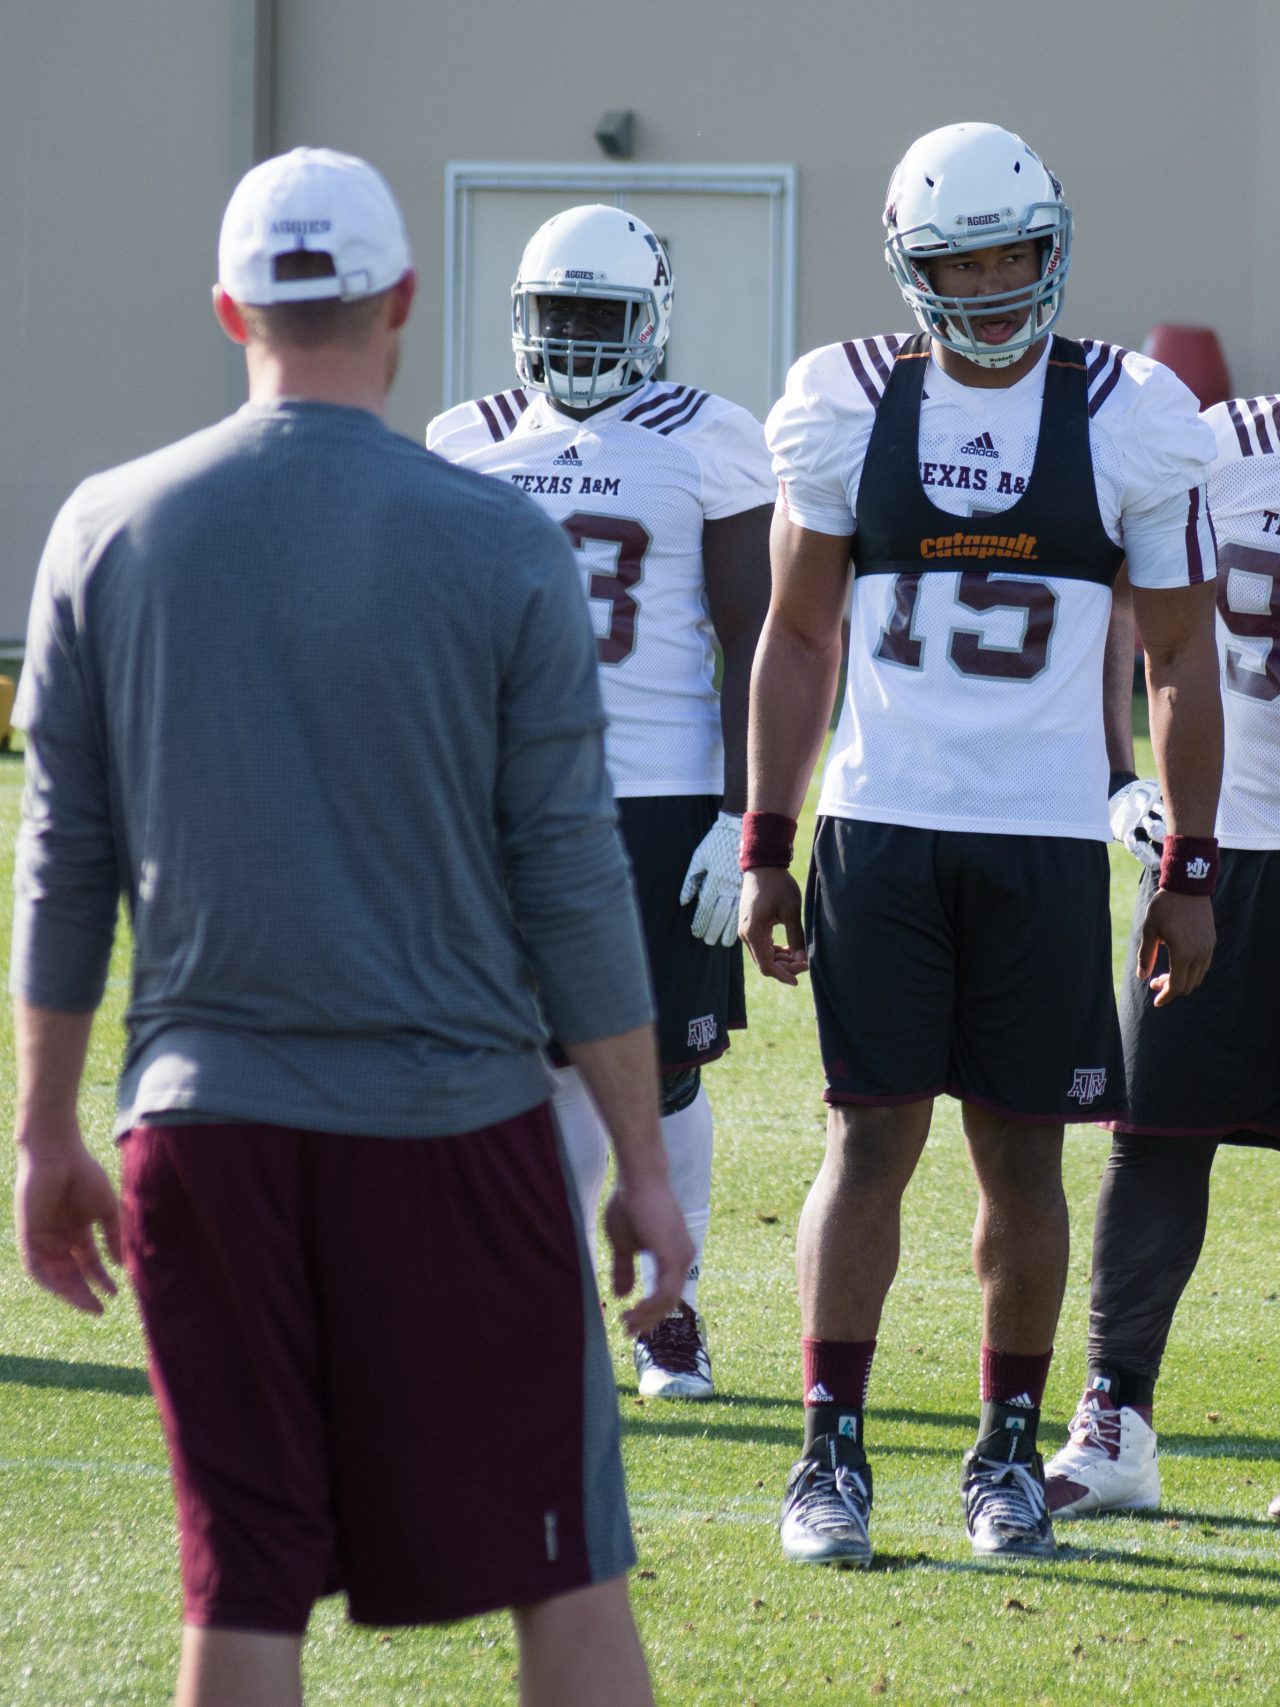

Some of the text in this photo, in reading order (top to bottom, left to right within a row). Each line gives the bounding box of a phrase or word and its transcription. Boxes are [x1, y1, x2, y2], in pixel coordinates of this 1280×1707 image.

[270, 219, 331, 234] AGGIES
[966, 213, 1000, 227] AGGIES
[565, 270, 594, 281] AGGIES
[960, 445, 1000, 459] adidas
[552, 458, 583, 467] adidas
[511, 474, 621, 496] TEXAS A&M
[919, 462, 1032, 495] EXAS A&
[873, 572, 1060, 685] 15
